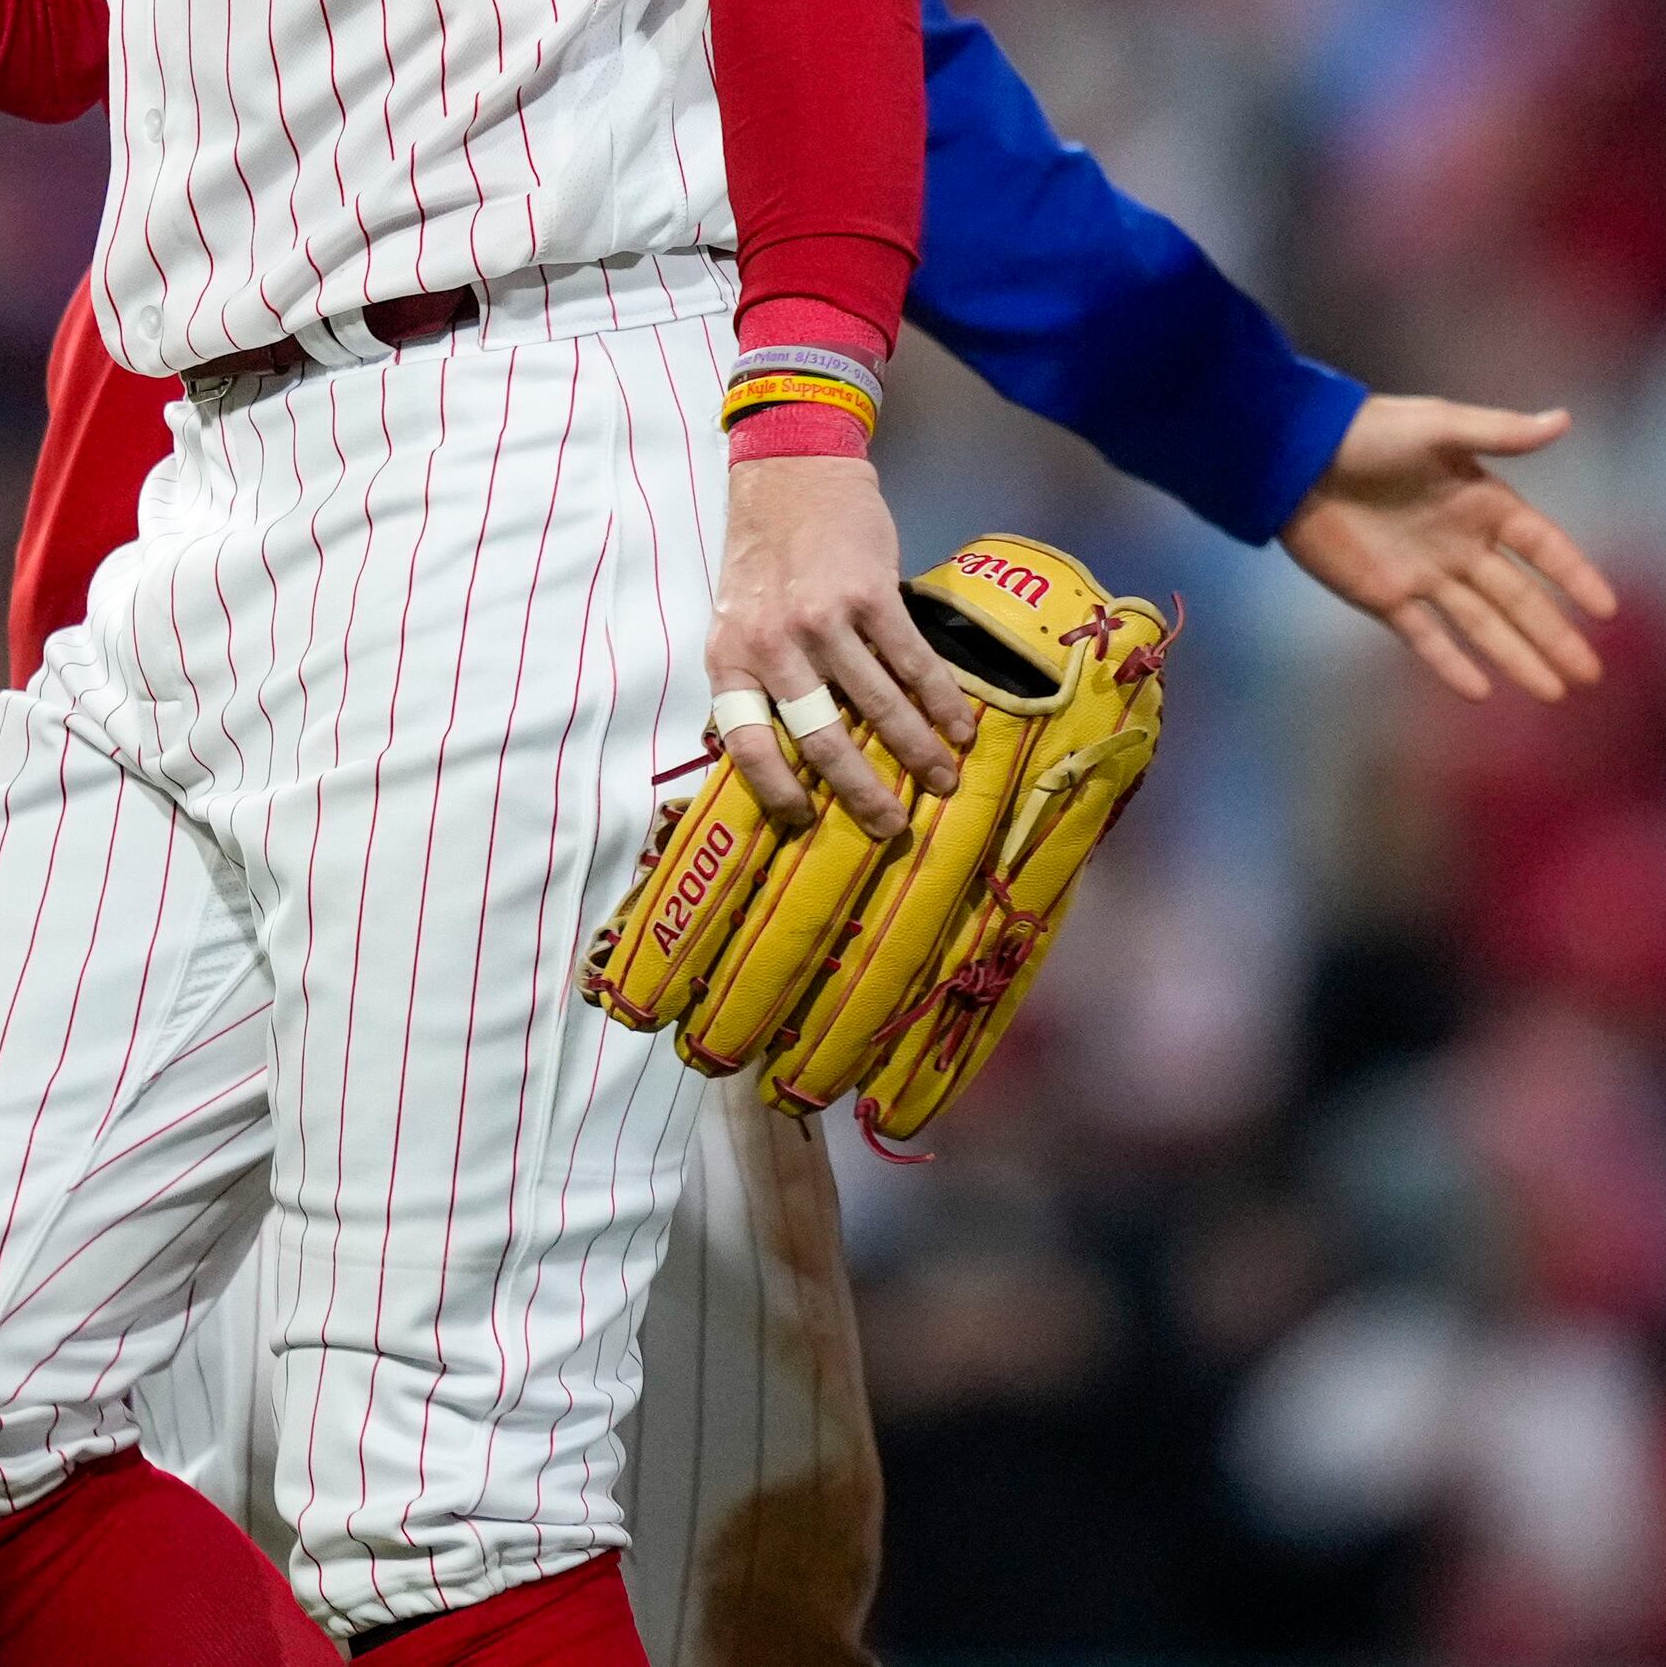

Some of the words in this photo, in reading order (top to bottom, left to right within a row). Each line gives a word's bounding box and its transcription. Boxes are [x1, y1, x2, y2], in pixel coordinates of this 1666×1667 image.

[746, 379, 777, 399] Kyle
[782, 378, 853, 403] Supports
[653, 822, 734, 957] A2000
